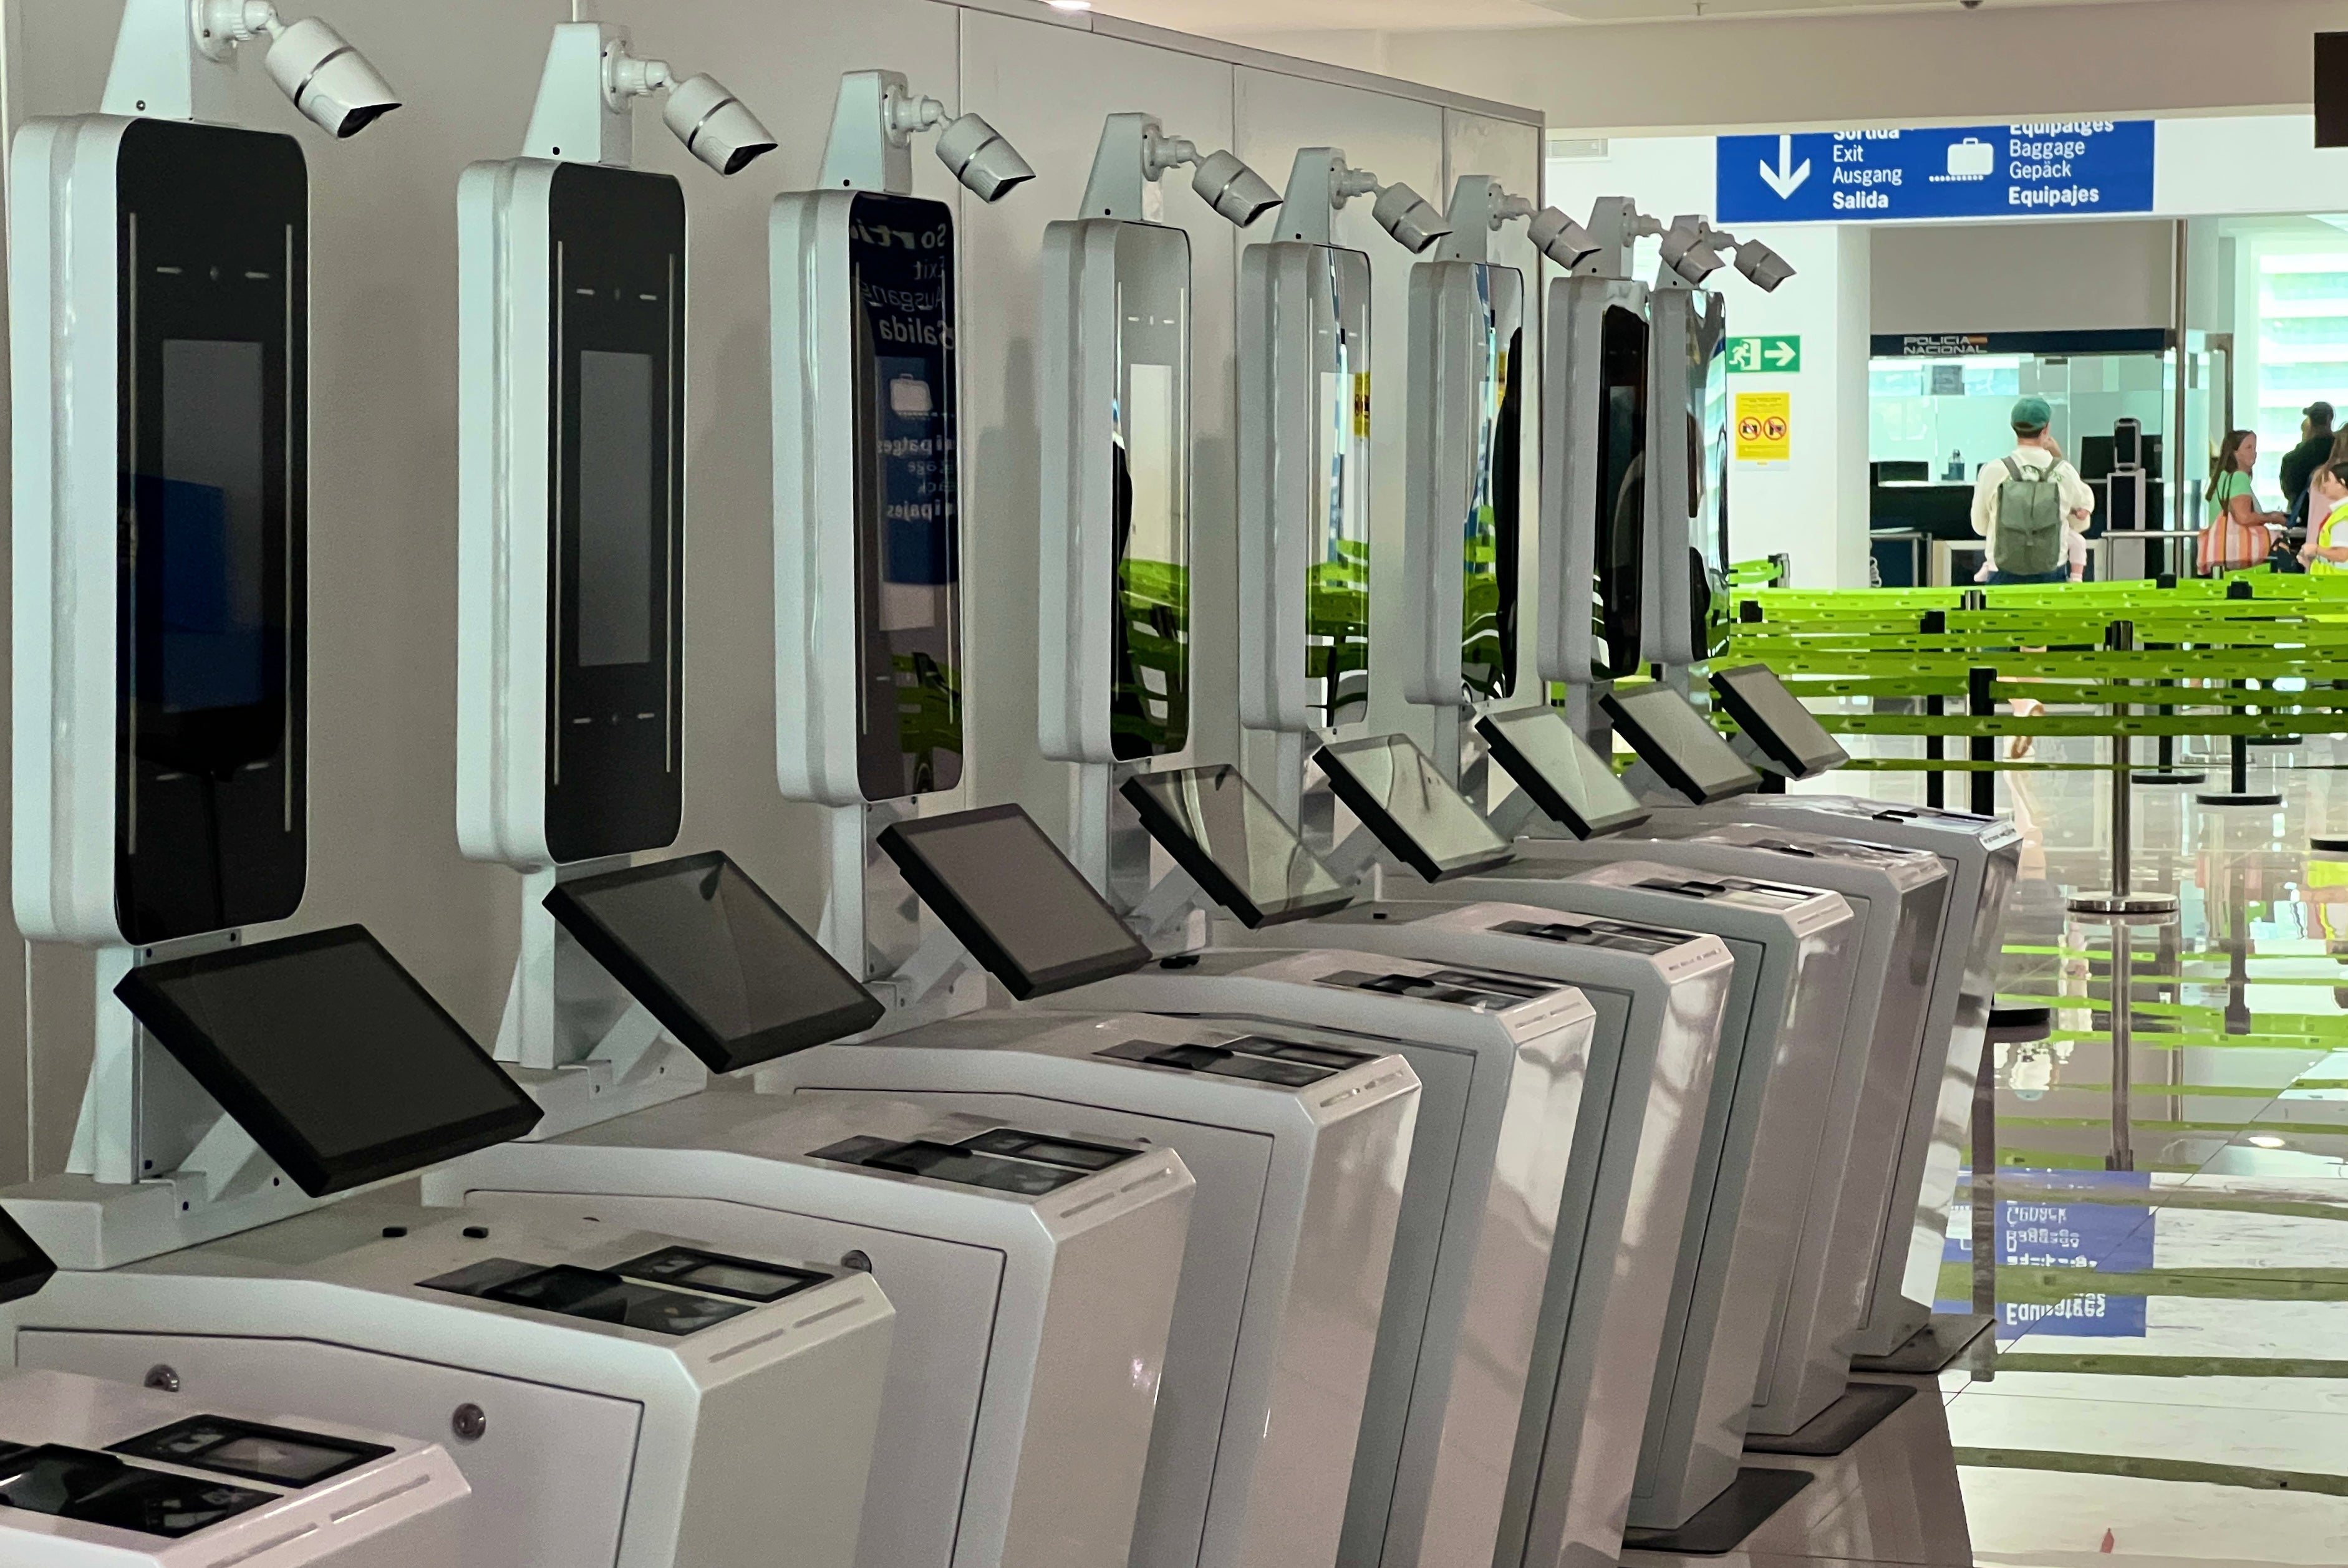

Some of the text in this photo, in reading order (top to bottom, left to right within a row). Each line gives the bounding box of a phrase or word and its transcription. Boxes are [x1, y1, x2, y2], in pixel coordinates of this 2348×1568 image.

[1833, 144, 1863, 162] Exit
[2009, 138, 2085, 160] Baggage
[1832, 166, 1902, 186] Ausgang
[2009, 160, 2071, 181] Gepäck
[1832, 190, 1889, 209] Salida
[2008, 185, 2099, 208] Equipajes
[1903, 345, 1988, 354] NACIONAL
